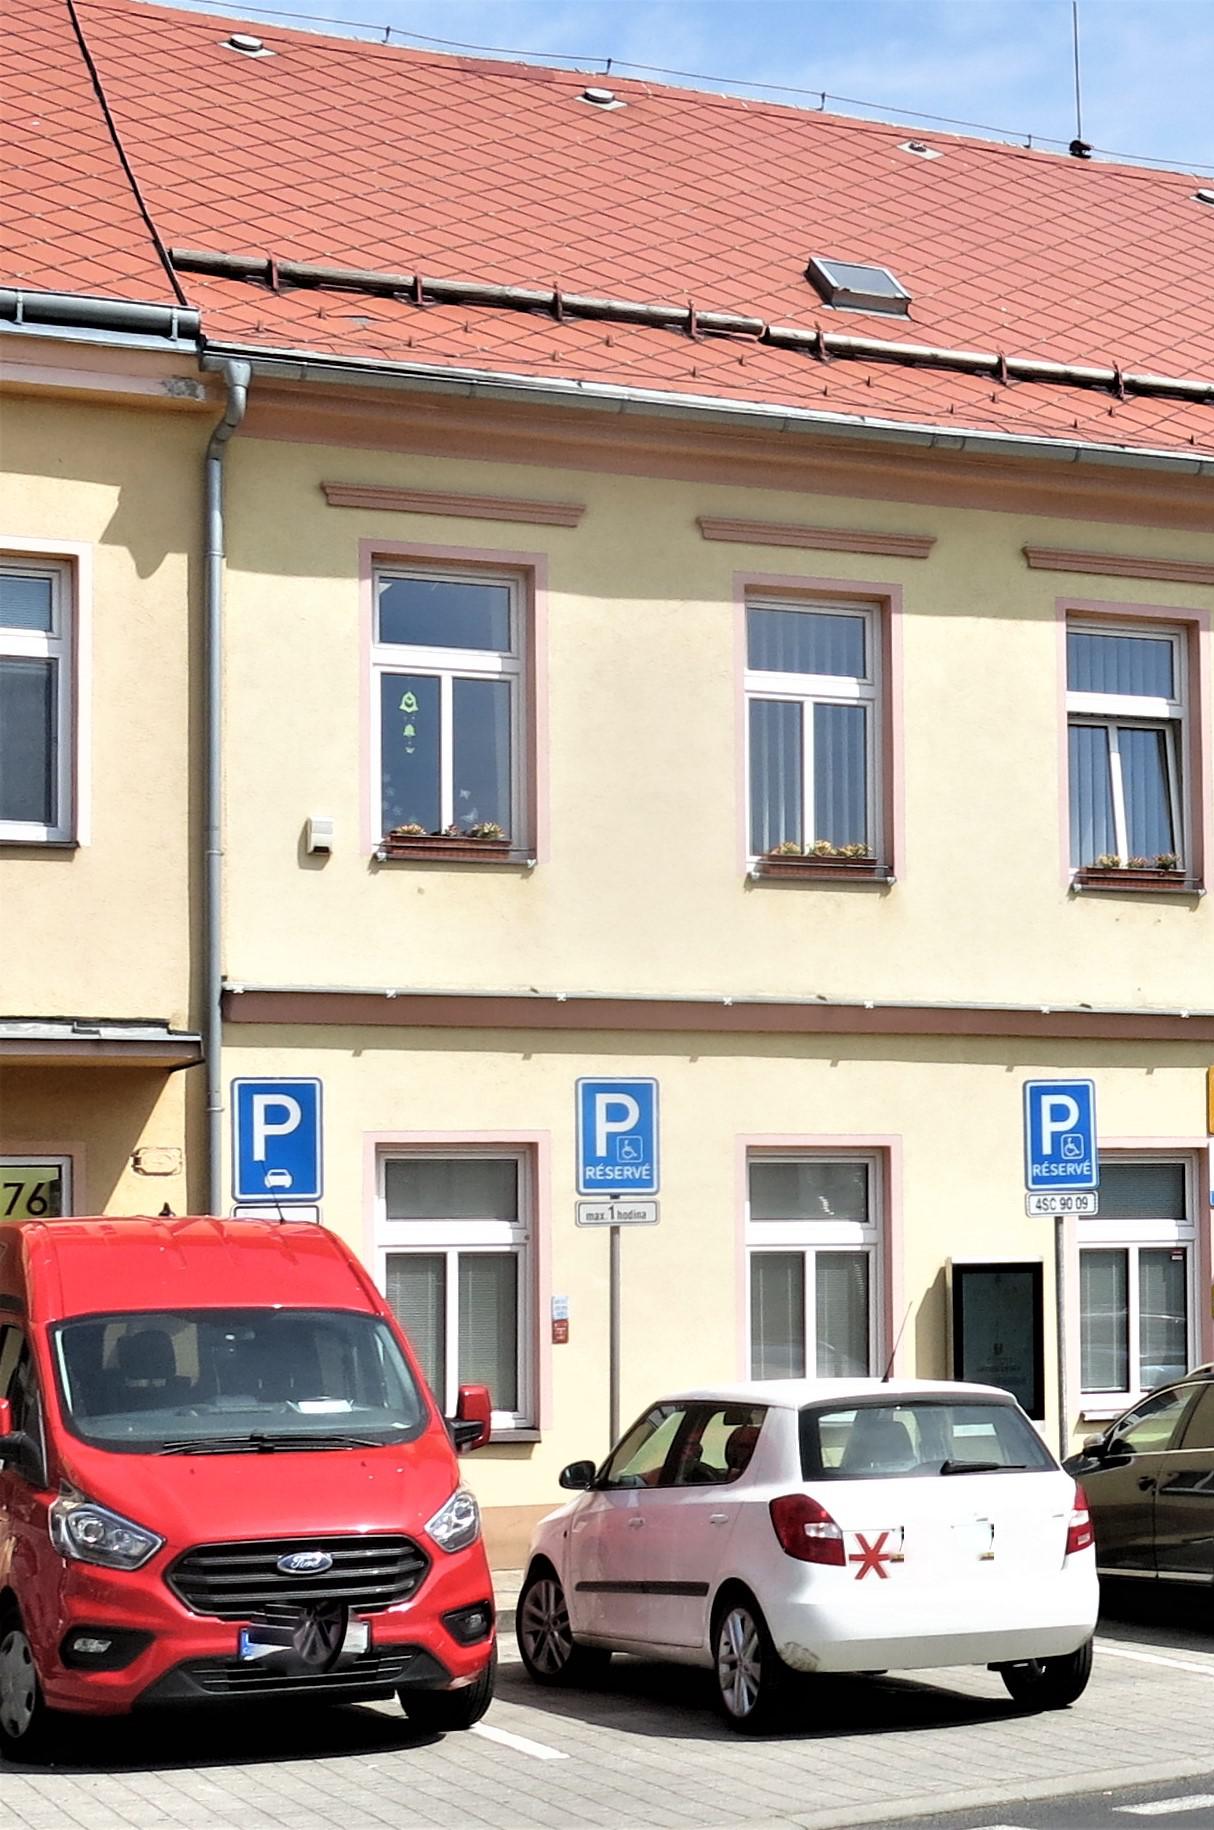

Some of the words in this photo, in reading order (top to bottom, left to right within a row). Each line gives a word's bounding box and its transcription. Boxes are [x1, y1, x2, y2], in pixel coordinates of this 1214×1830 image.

[252, 1093, 302, 1161] P
[595, 1092, 640, 1157] P
[1040, 1094, 1080, 1156] P
[585, 1162, 651, 1180] RÉSERVÉ
[1032, 1158, 1092, 1177] RÉSERVÉ
[3, 1182, 48, 1216] 76
[1035, 1197, 1057, 1211] 4SC
[1059, 1196, 1073, 1210] 90
[1075, 1196, 1089, 1209] 09
[607, 1205, 615, 1220] 1
[616, 1209, 647, 1220] hodina
[290, 1552, 322, 1569] Ford
